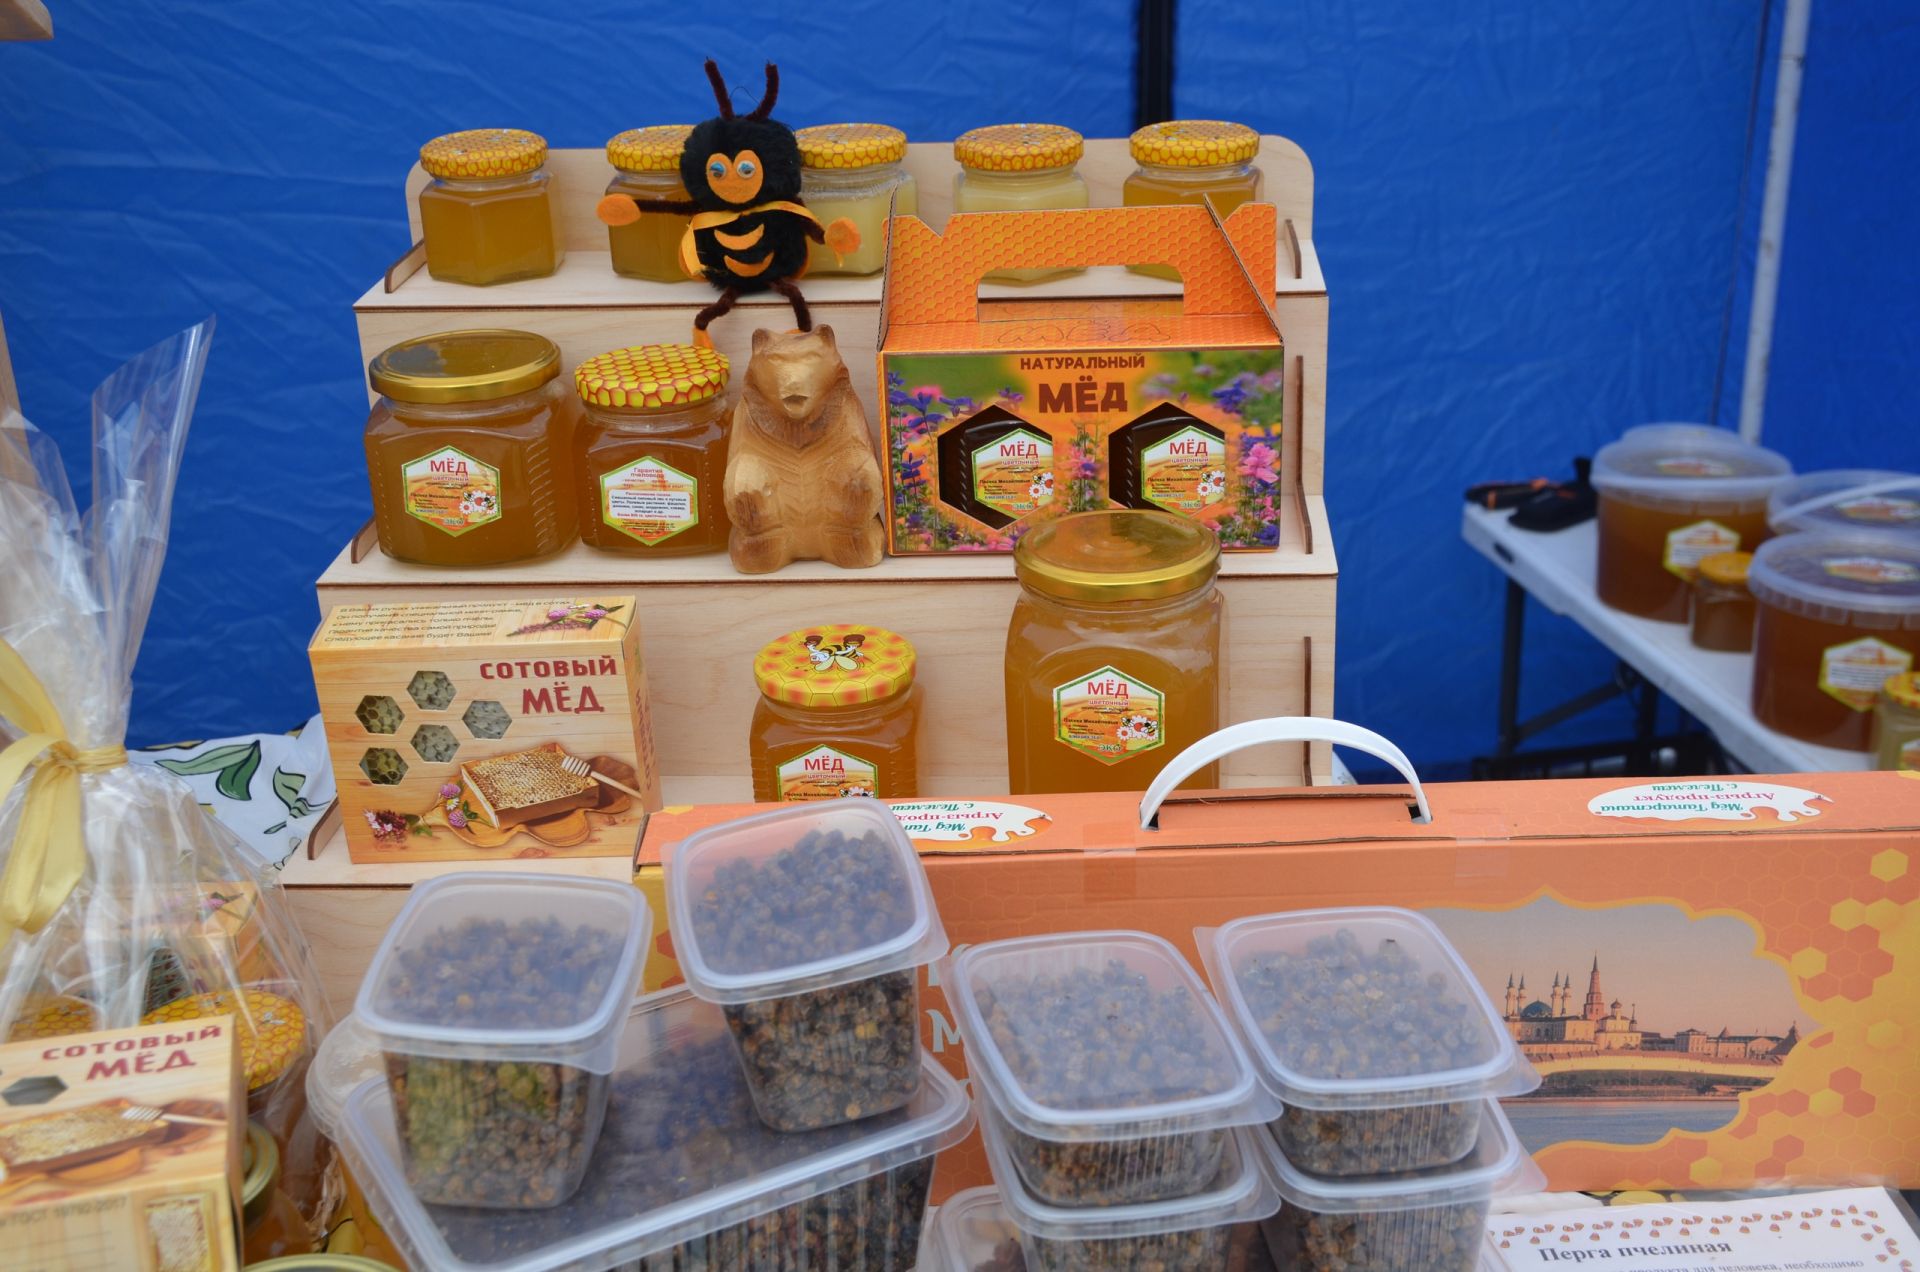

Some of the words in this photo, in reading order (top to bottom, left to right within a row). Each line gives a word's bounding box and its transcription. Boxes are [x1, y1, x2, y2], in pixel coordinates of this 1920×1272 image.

[1020, 355, 1145, 371] НАТУРАЛЬНЫЙ
[1038, 375, 1129, 413] МЁД
[1000, 441, 1039, 459] МЁД
[1169, 438, 1208, 456] МЁД
[430, 458, 468, 476] МЁД
[479, 655, 617, 680] СОТОВЫЙ
[521, 682, 605, 714] МЁД
[1087, 679, 1129, 699] МЁД
[804, 755, 845, 773] МЁД
[1633, 792, 1776, 801] Агрыз-продукт
[1601, 801, 1709, 812] Татарстана
[1710, 802, 1744, 812] Мёд
[895, 812, 1004, 821] Агрыз-прод
[935, 822, 966, 832] Мёд
[42, 1025, 222, 1060] СОТОВЫЙ
[86, 1050, 197, 1081] МЁД
[1539, 1246, 1612, 1263] Перга
[1618, 1240, 1733, 1257] пчелиная
[1784, 1259, 1865, 1270] необходимо
